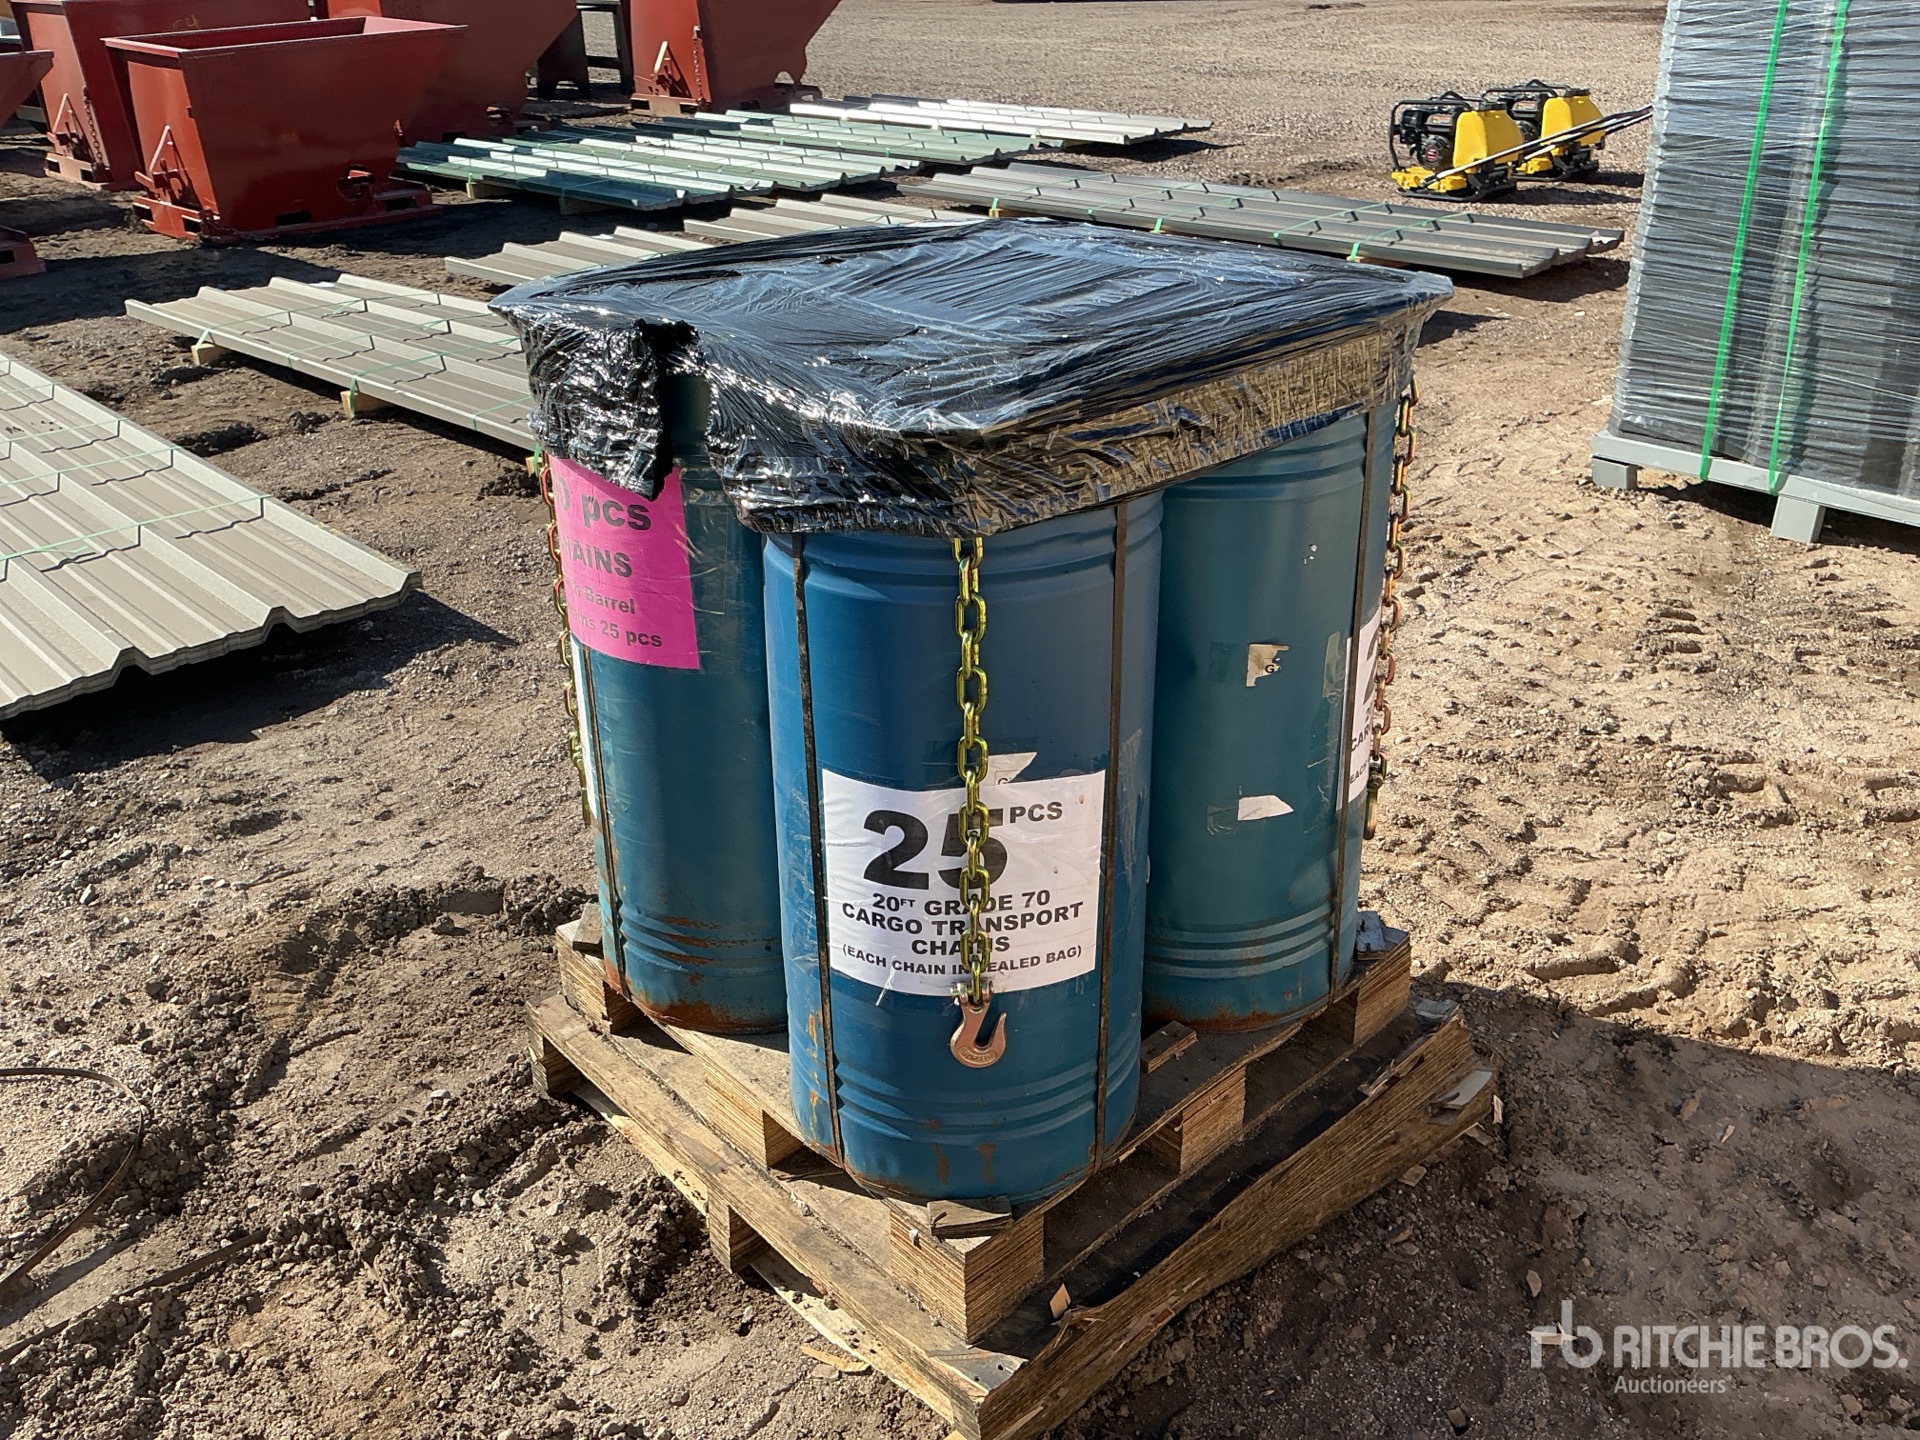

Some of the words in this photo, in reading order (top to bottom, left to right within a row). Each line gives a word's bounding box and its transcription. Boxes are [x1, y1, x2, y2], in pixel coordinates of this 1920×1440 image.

[582, 494, 651, 530] pcs
[584, 585, 636, 614] Barrel
[600, 619, 620, 639] 25
[626, 630, 663, 648] pcs
[863, 808, 1008, 890] 25
[1009, 801, 1063, 823] PCS
[842, 902, 923, 935] CARGO
[931, 901, 1084, 936] TRNSPORT
[872, 892, 916, 912] 20FT
[924, 894, 1013, 916] GRDE
[1021, 889, 1051, 908] 70
[842, 943, 887, 968] (EACH
[891, 959, 946, 975] CHAIN
[986, 955, 1041, 973] EALED
[1046, 945, 1082, 964] BAG)
